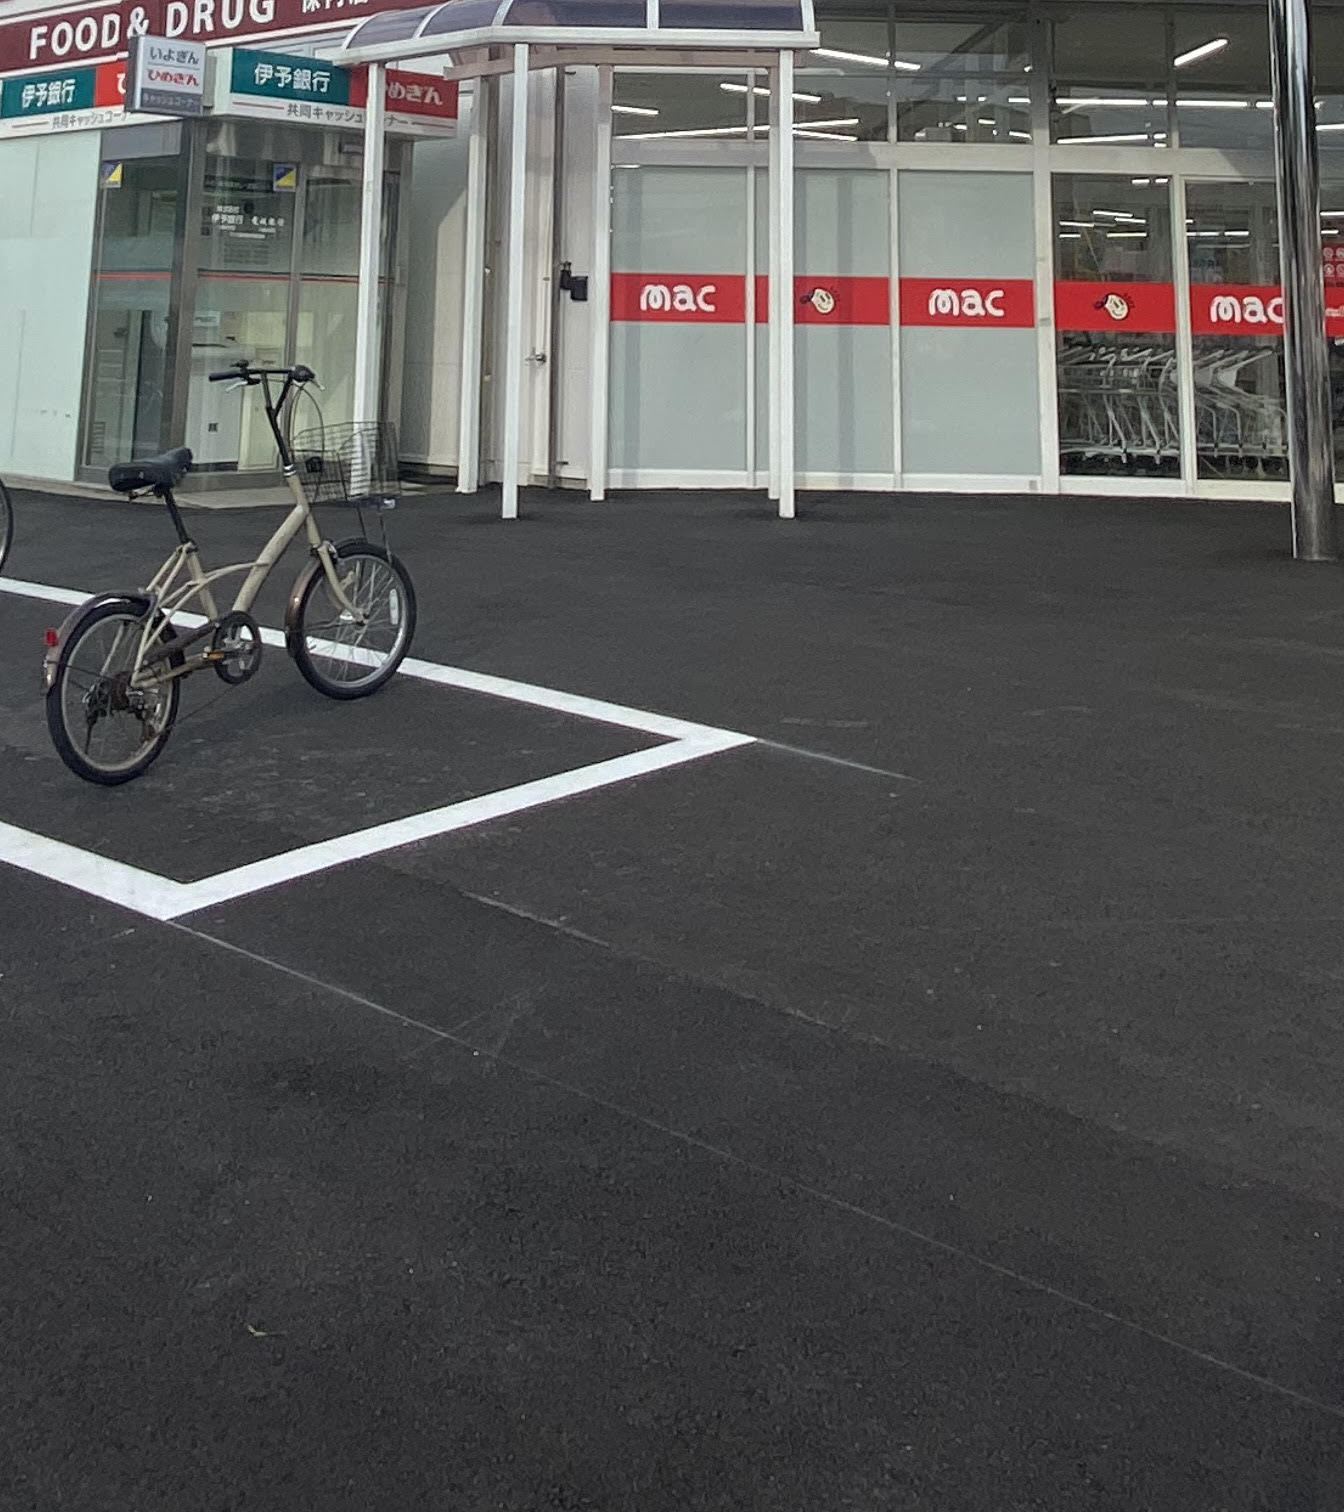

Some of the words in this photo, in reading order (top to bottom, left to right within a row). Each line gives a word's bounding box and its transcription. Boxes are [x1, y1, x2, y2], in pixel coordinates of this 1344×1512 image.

[150, 47, 200, 65] いよぎん
[147, 69, 200, 86] ひめぎん
[254, 63, 331, 93] 伊予銀行
[21, 79, 76, 108] 伊予銀行
[385, 81, 444, 106] めぎん
[52, 111, 127, 130] 共同キャッシュコー
[287, 102, 409, 127] 共同キャッシュナー
[640, 284, 717, 313] mac
[928, 288, 1006, 318] mac
[1209, 295, 1285, 325] mac
